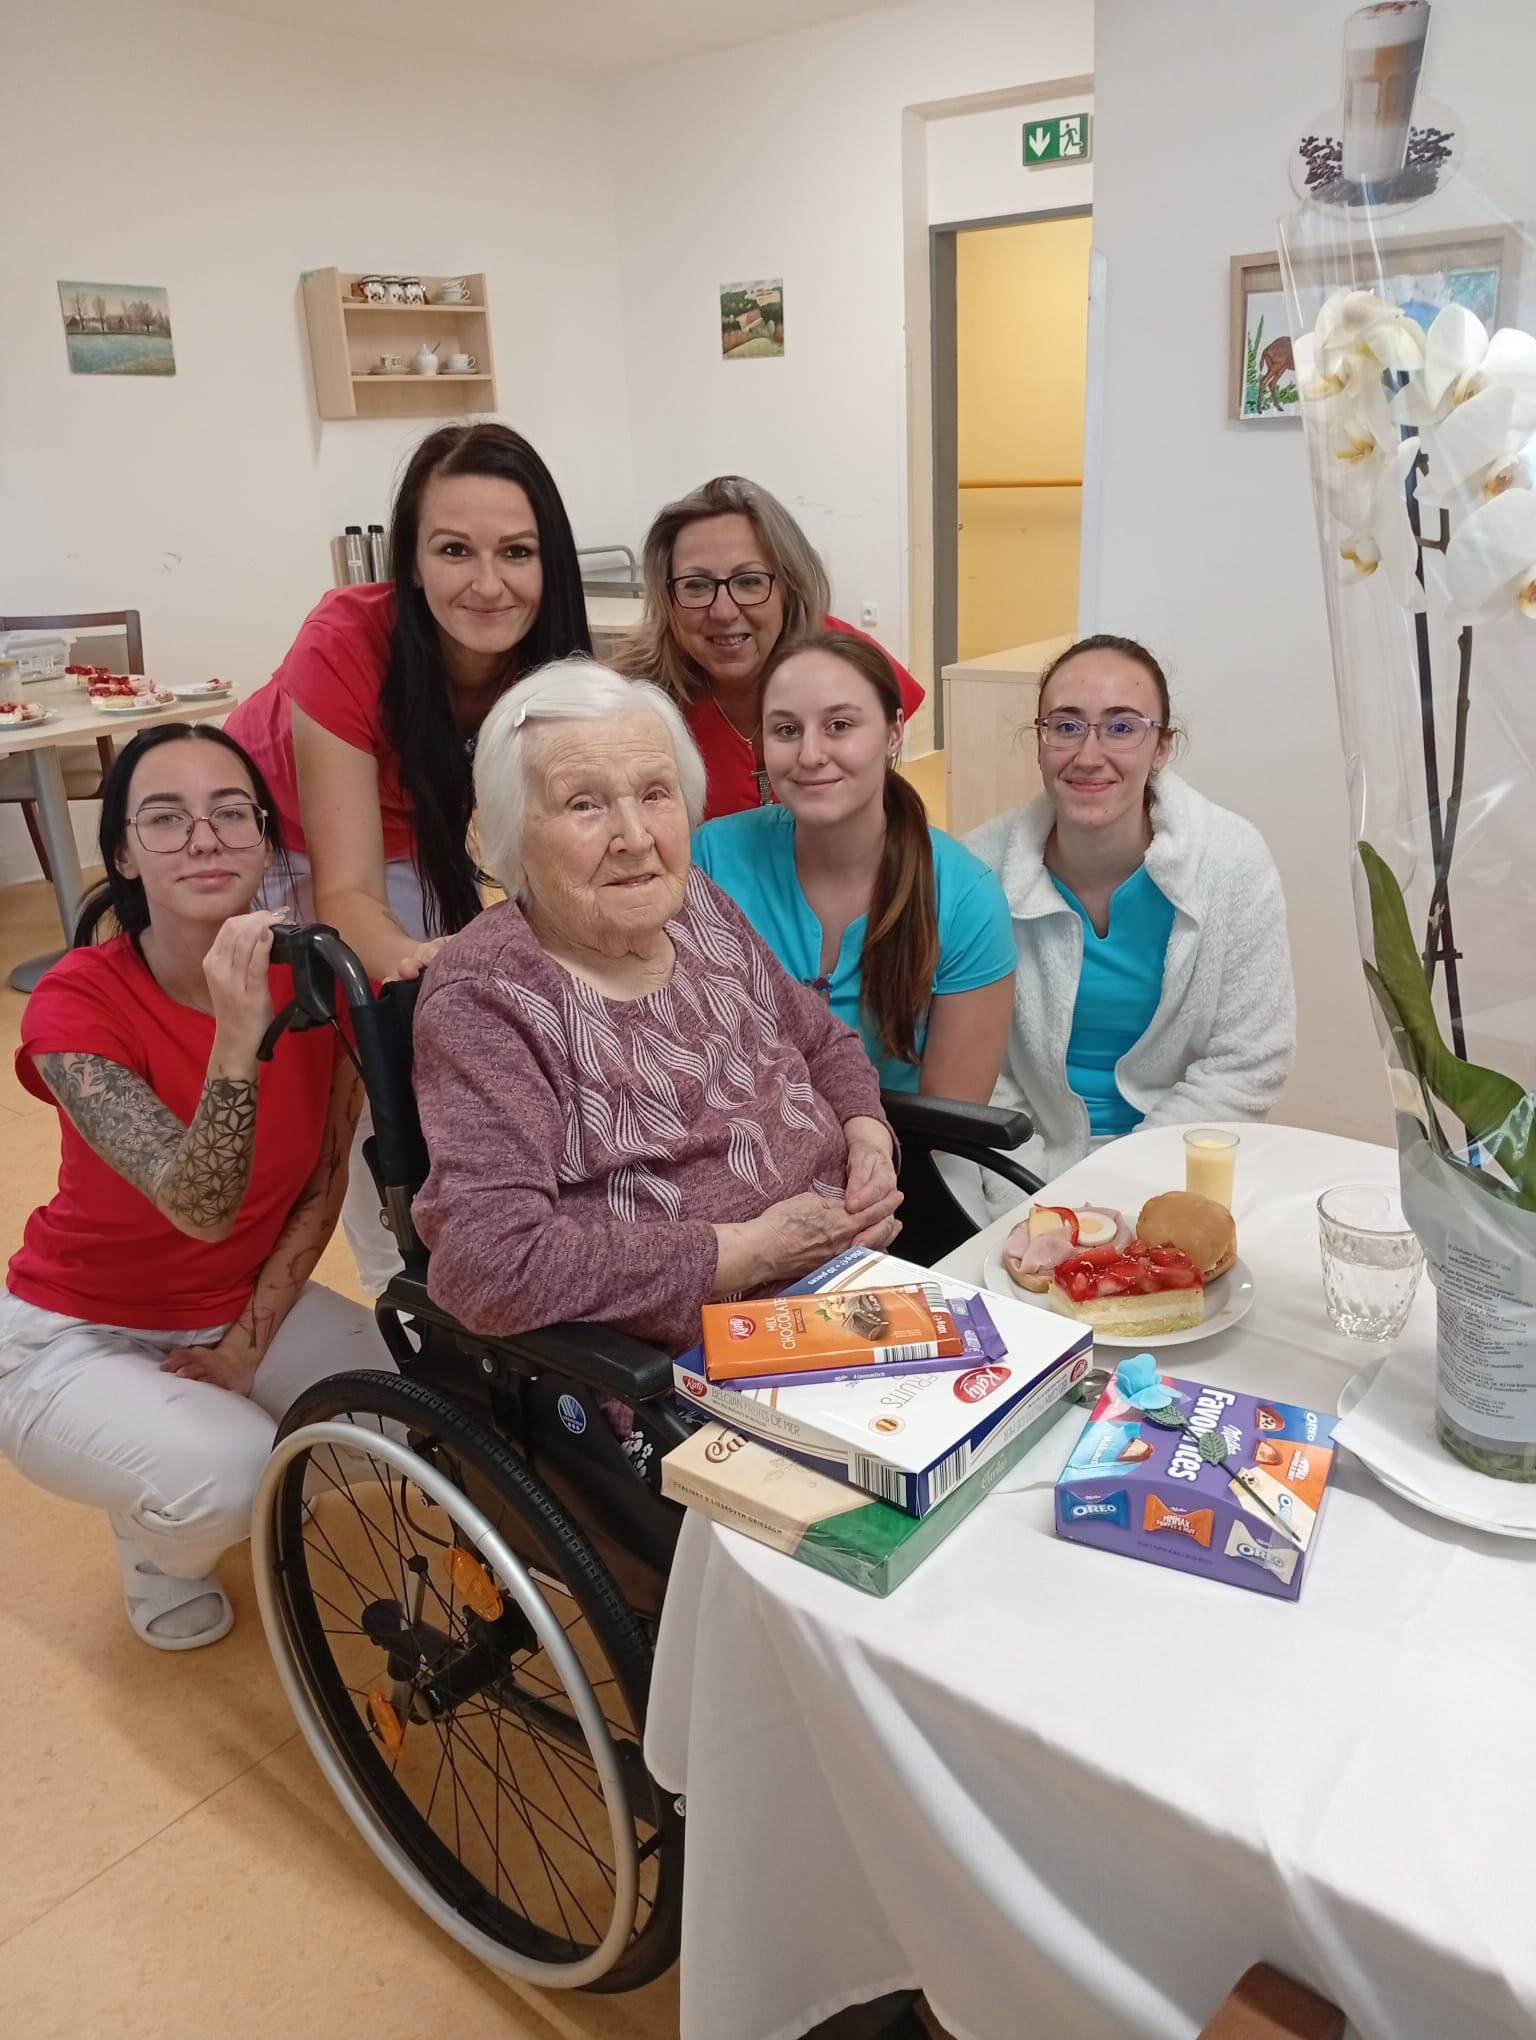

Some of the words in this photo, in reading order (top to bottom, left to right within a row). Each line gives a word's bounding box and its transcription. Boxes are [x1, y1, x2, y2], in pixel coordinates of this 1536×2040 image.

[729, 1318, 752, 1337] Katy
[765, 1316, 777, 1332] MILK
[773, 1298, 796, 1350] CHOCOLATE
[687, 1379, 704, 1394] Katy
[963, 1366, 1002, 1400] Katy
[711, 1387, 743, 1409] BELGIAN
[744, 1399, 770, 1423] FRUITS
[770, 1415, 782, 1429] DE
[783, 1420, 801, 1436] MER
[1304, 1411, 1318, 1442] OREO
[1220, 1424, 1243, 1455] Milka
[1072, 1504, 1117, 1517] OREO
[1163, 1515, 1190, 1529] MMMAX
[1183, 1527, 1197, 1535] NUT
